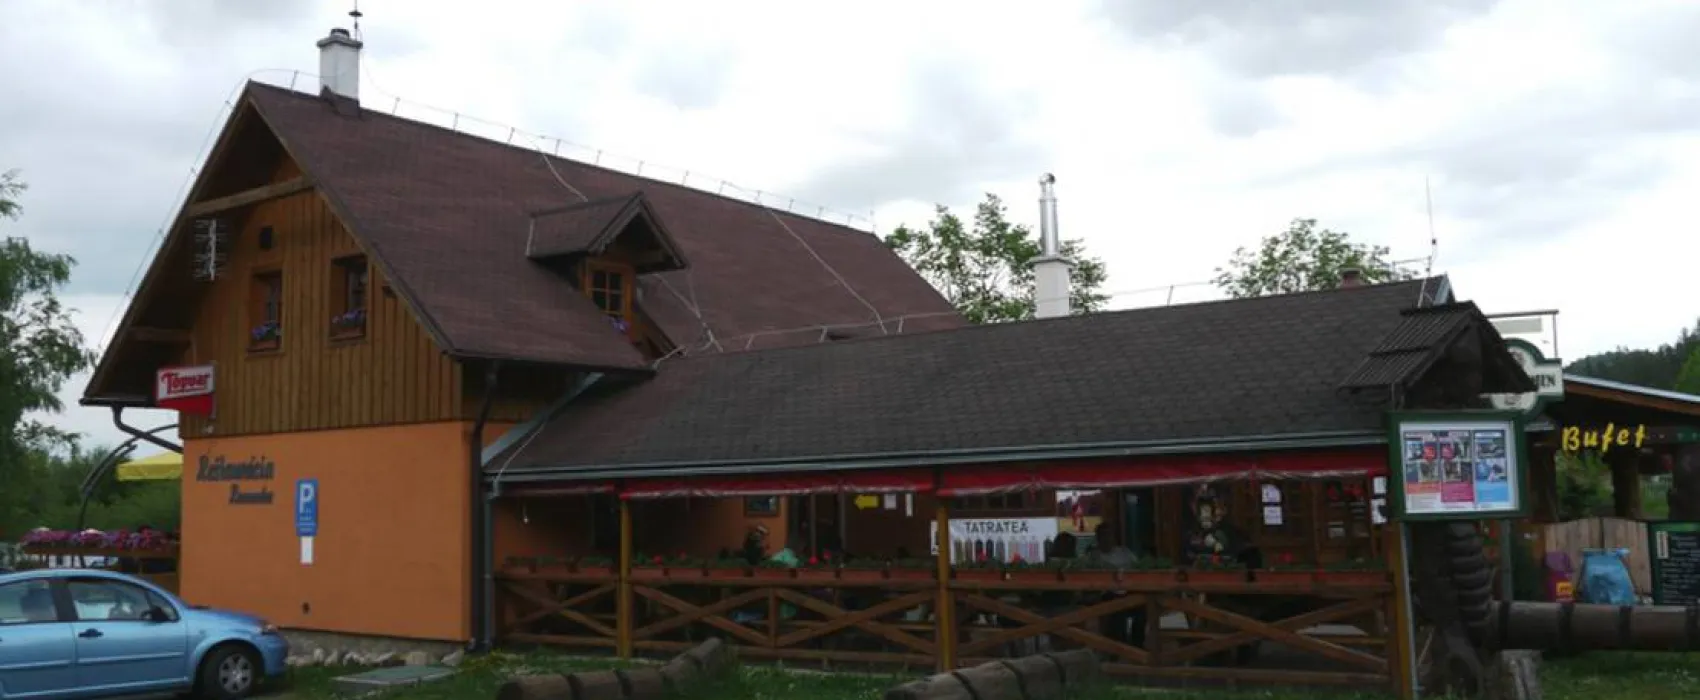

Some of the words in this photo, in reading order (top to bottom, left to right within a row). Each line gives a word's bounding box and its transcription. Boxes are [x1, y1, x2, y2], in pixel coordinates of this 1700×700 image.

[1562, 423, 1646, 452] Bufet
[299, 483, 314, 513] P
[965, 520, 1029, 534] TATRATEA
